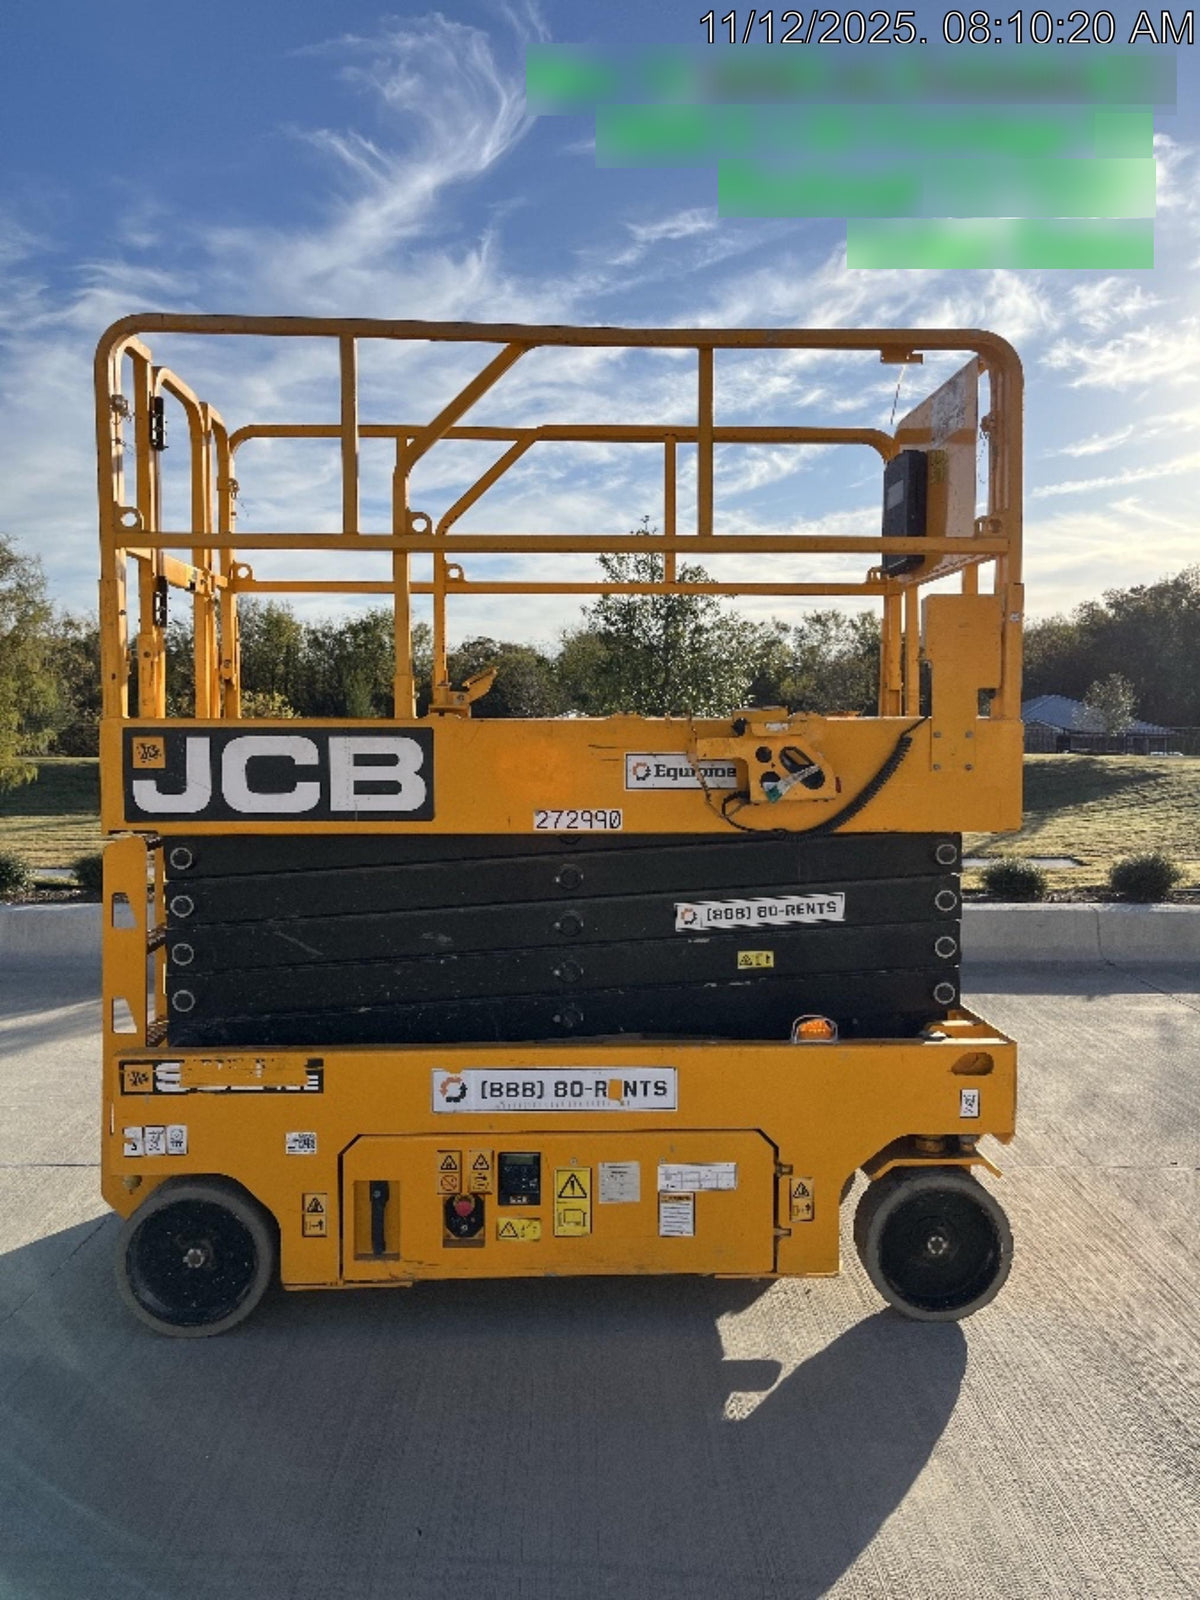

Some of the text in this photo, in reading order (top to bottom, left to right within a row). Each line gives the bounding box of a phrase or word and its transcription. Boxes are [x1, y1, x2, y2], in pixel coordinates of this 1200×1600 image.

[132, 735, 427, 814] JCB
[536, 809, 621, 829] 272990
[757, 900, 837, 918] 80-RENTS
[554, 1078, 668, 1098] 80-RNTS
